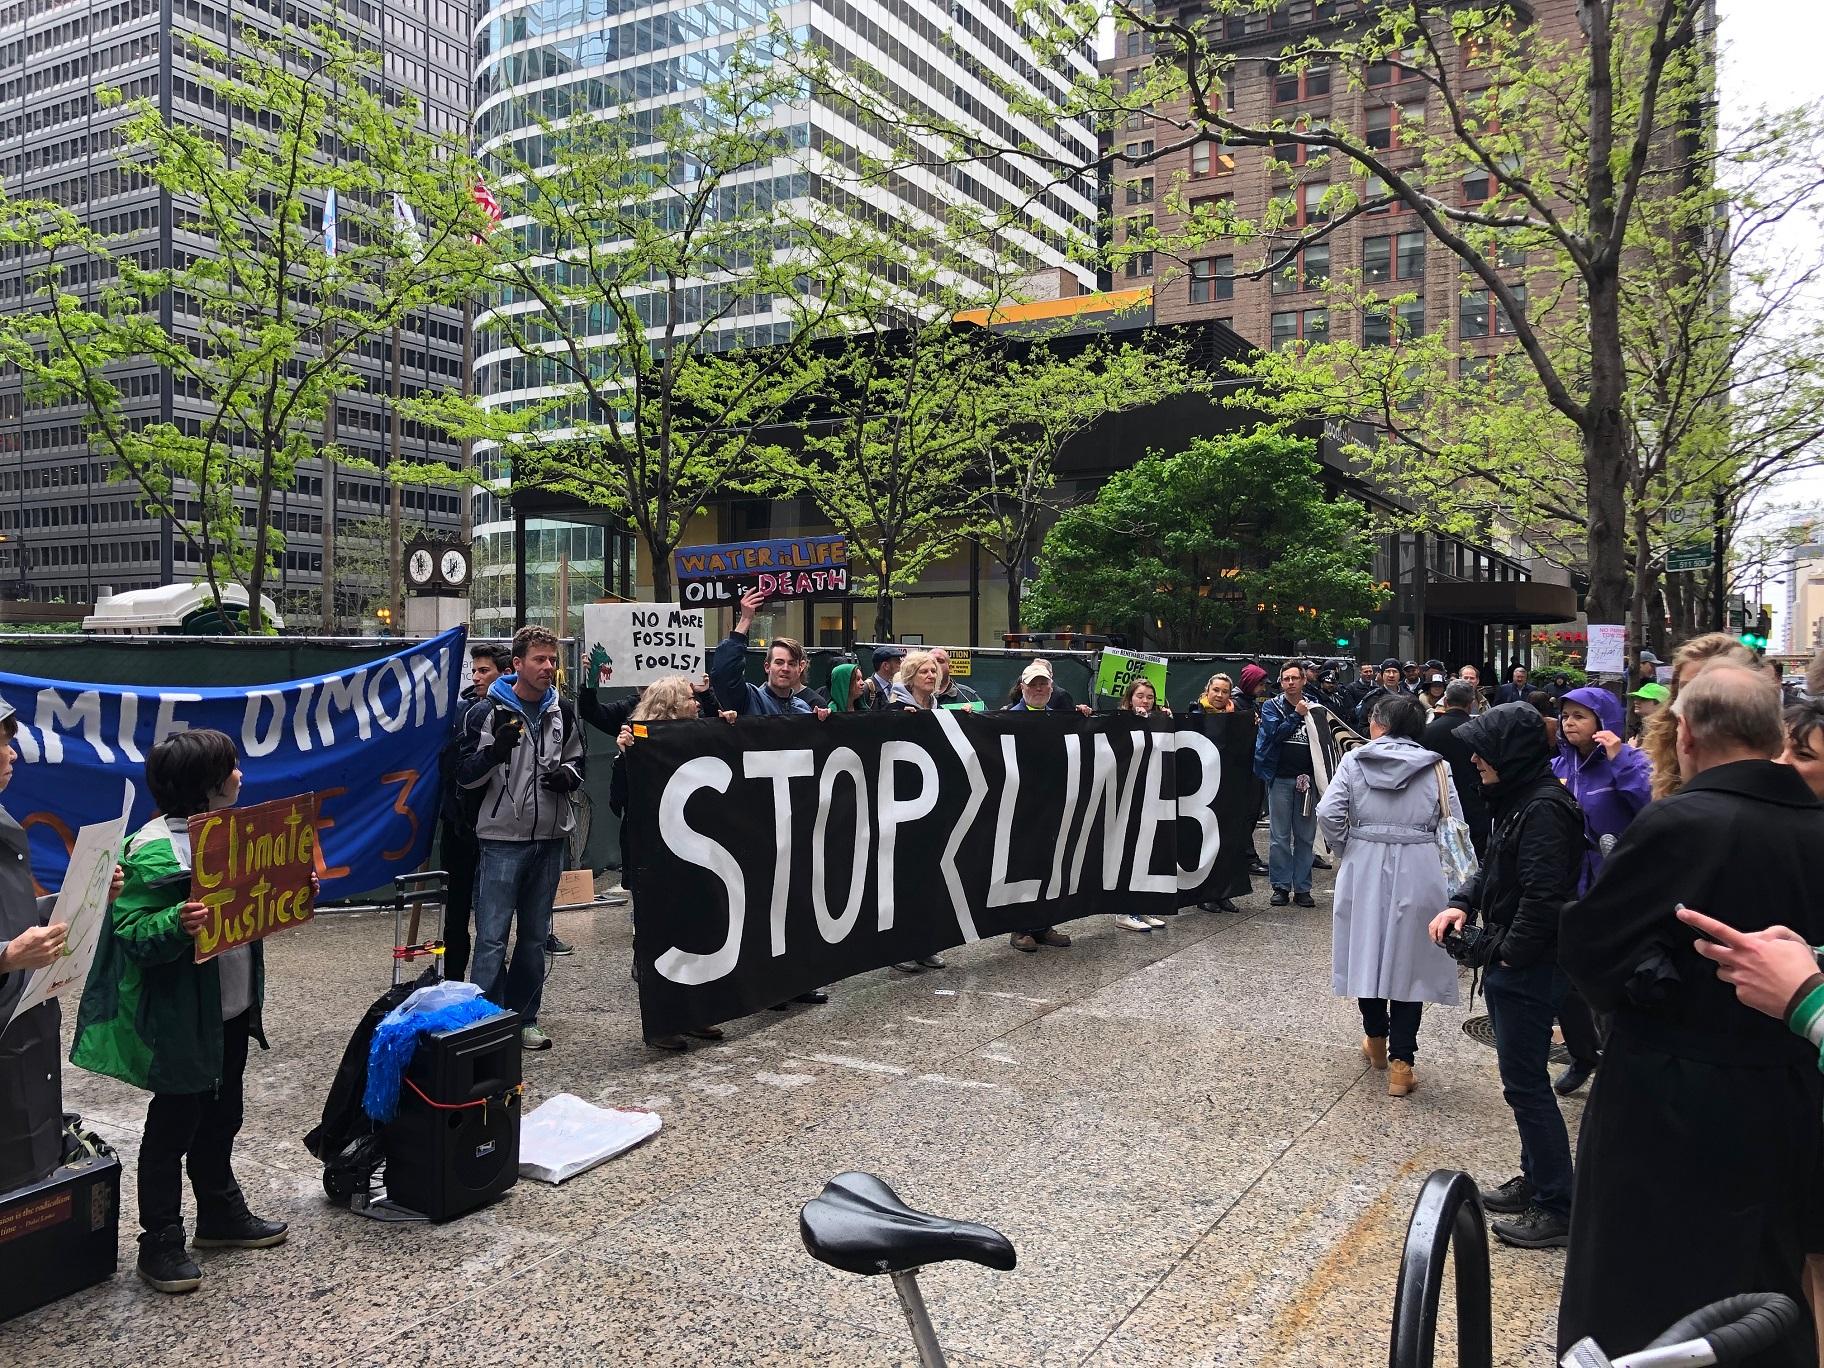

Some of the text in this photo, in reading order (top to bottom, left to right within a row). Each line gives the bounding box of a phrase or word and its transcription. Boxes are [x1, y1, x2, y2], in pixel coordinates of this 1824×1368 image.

[681, 548, 774, 574] WATER
[791, 541, 847, 567] LIFE
[685, 582, 732, 602] OIL
[758, 568, 847, 597] DEATH
[632, 610, 704, 629] NO MORE
[632, 630, 696, 648] FOSSIL
[948, 650, 969, 659] UTION
[634, 653, 701, 674] FOOLS!
[240, 647, 452, 758] DIMON
[380, 768, 421, 861] 3
[195, 803, 314, 889] Climate
[654, 740, 940, 986] STOP
[986, 730, 1178, 908] LINE
[198, 874, 312, 954] Justice
